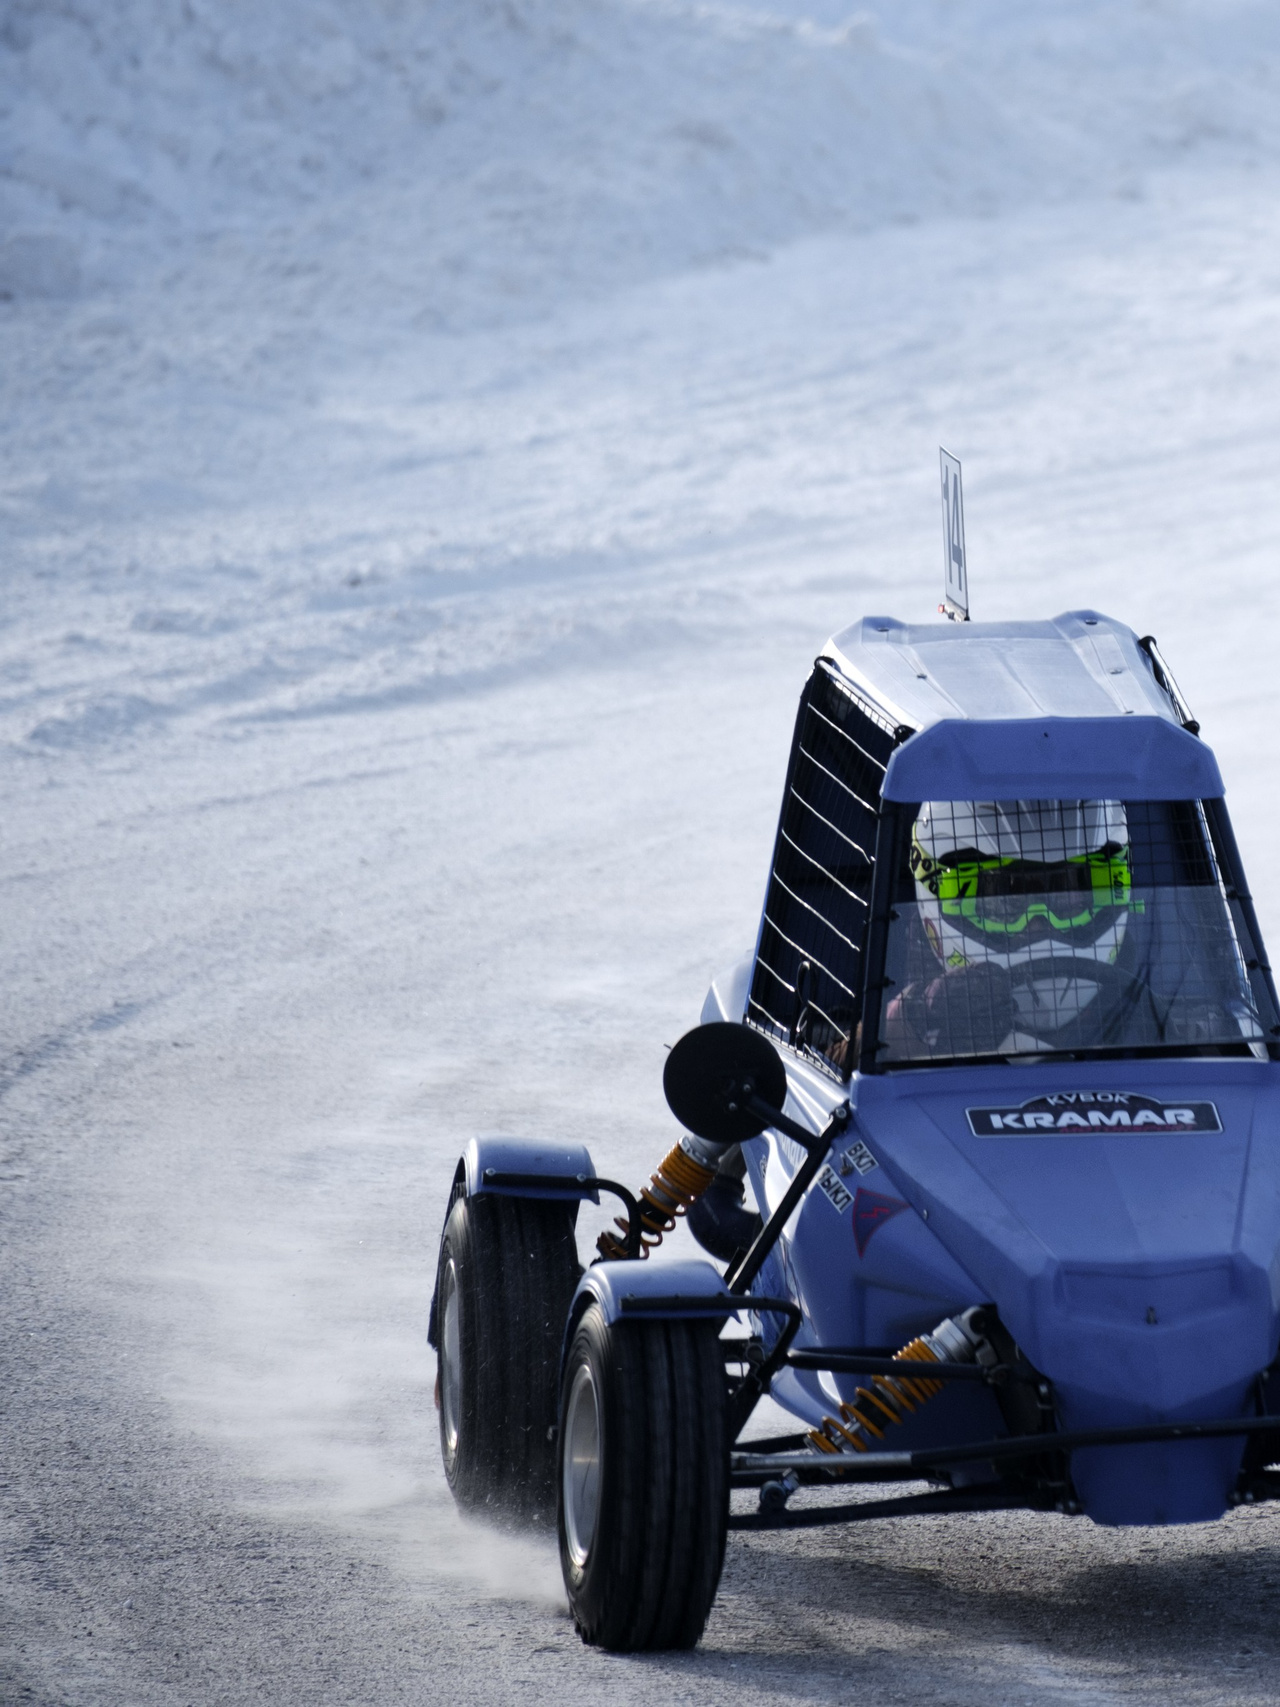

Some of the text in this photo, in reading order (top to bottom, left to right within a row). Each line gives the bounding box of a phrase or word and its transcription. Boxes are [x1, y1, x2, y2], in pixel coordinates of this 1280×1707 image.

[943, 465, 963, 592] 14
[989, 1109, 1198, 1129] KRAMAR
[847, 1142, 877, 1174] ВКЛ
